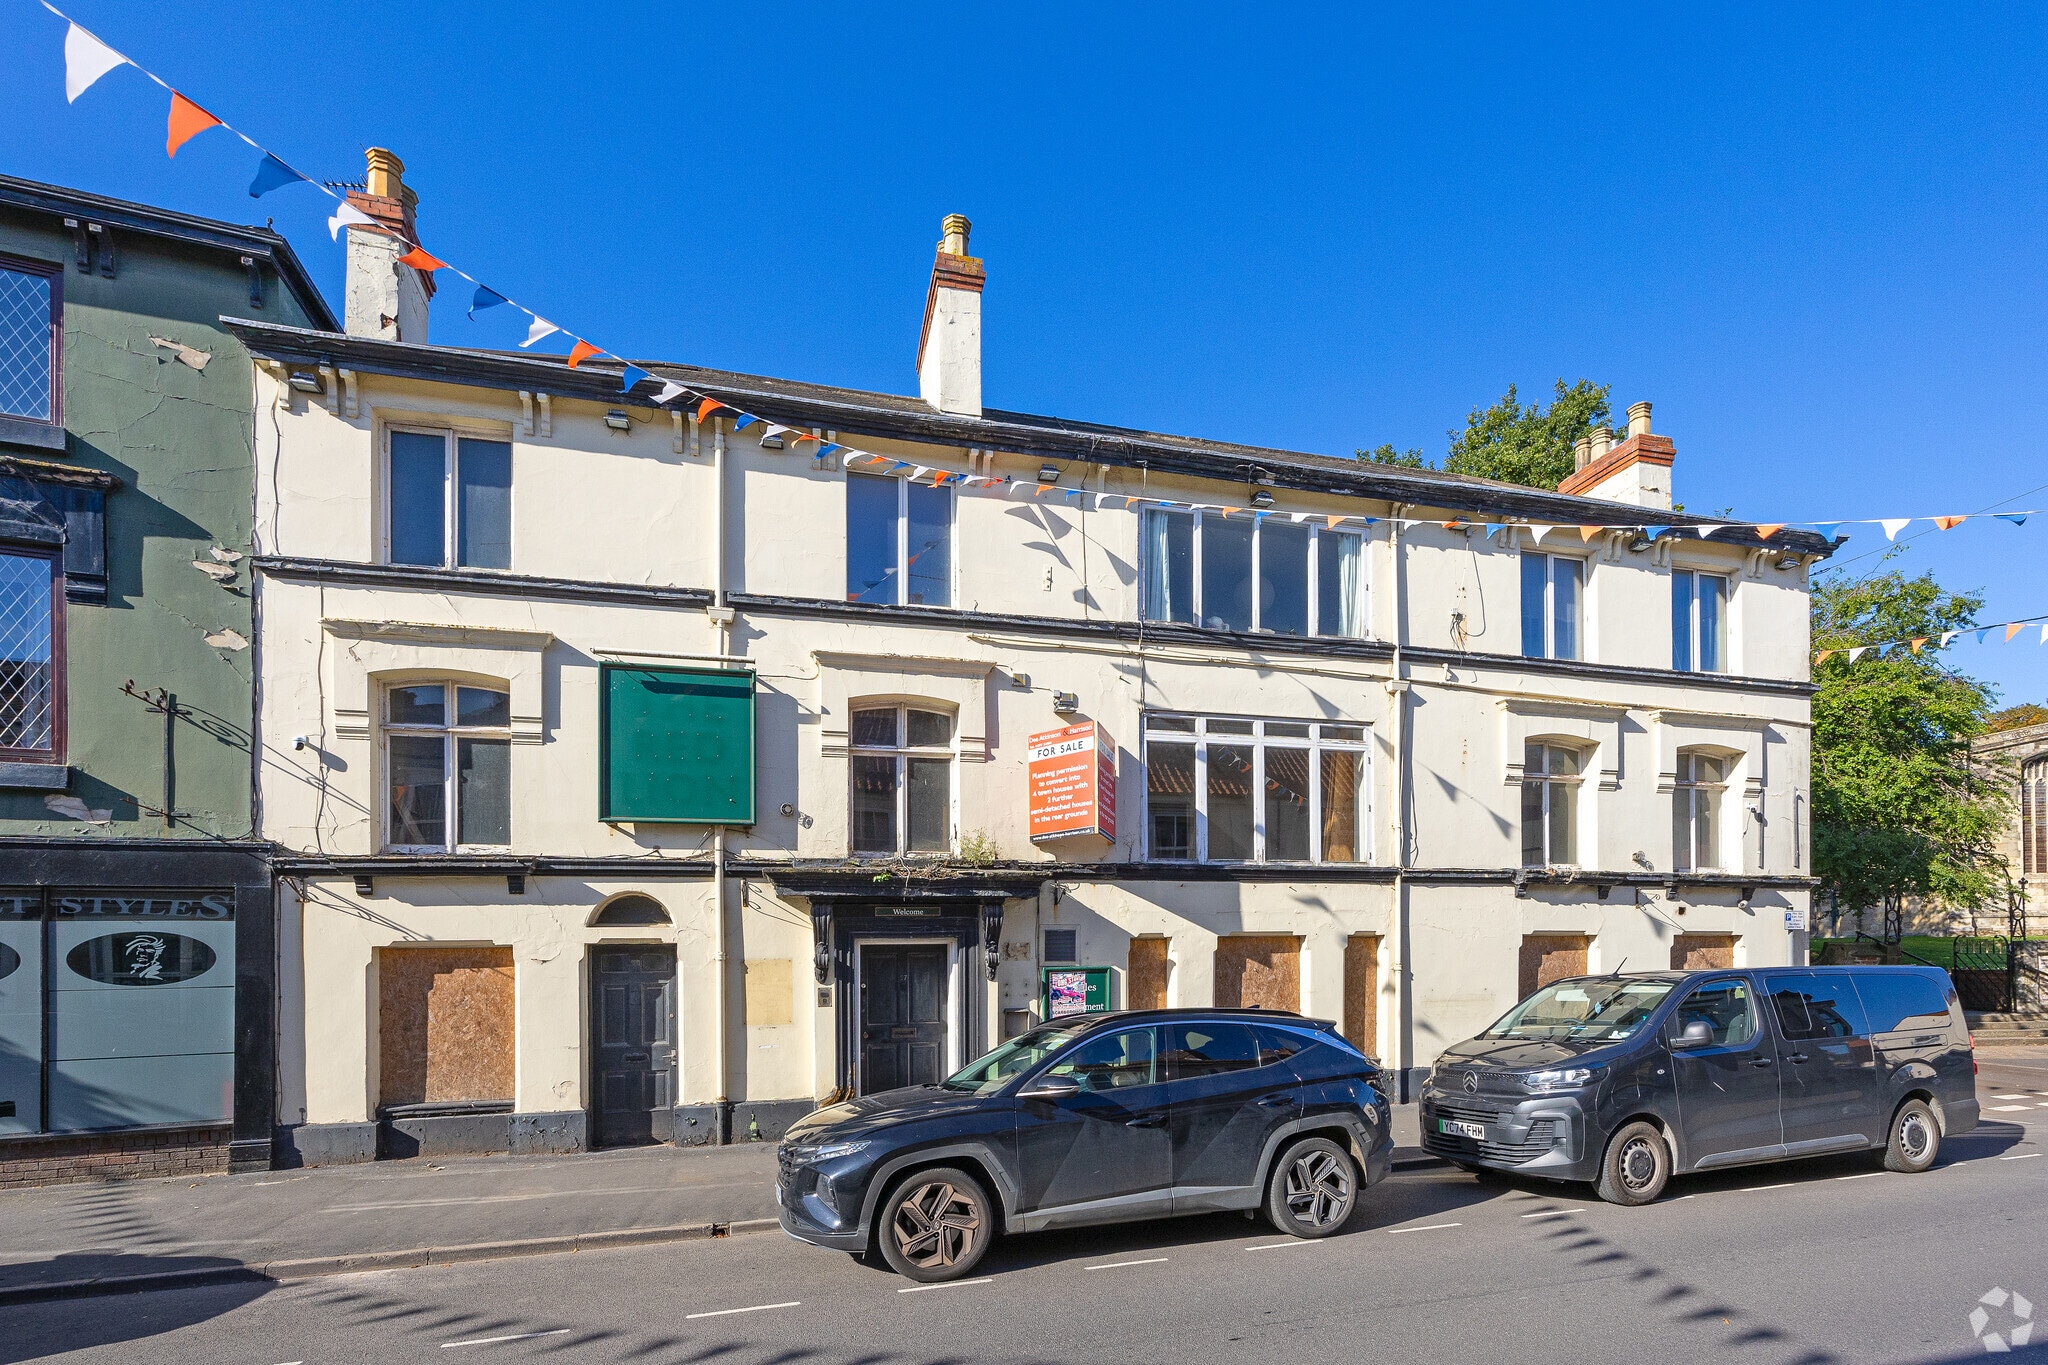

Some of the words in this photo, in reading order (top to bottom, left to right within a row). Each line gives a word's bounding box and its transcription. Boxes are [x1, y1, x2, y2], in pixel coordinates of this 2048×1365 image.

[1039, 731, 1061, 741] Atkinson
[1062, 728, 1070, 737] &
[1069, 724, 1093, 734] Harrison
[1037, 746, 1056, 758] FOR
[1060, 740, 1084, 754] SALE
[1032, 769, 1055, 780] Planning
[1056, 763, 1088, 776] permission
[1037, 787, 1052, 796] town
[1053, 785, 1073, 793] houses
[1074, 781, 1088, 790] with
[1046, 776, 1068, 786] convert
[1047, 796, 1051, 804] 2
[1052, 794, 1074, 803] further
[1030, 802, 1070, 816] semi-detached
[1072, 800, 1093, 808] houses
[1034, 816, 1040, 824] in
[1051, 813, 1064, 821] rear
[1064, 809, 1088, 821] grounds
[0, 896, 34, 915] T
[59, 894, 231, 919] STYLES
[892, 908, 924, 916] Welcome
[1085, 982, 1097, 992] les
[1085, 1003, 1105, 1011] ment
[1444, 1121, 1465, 1135] YC74
[1466, 1124, 1483, 1137] FHM
